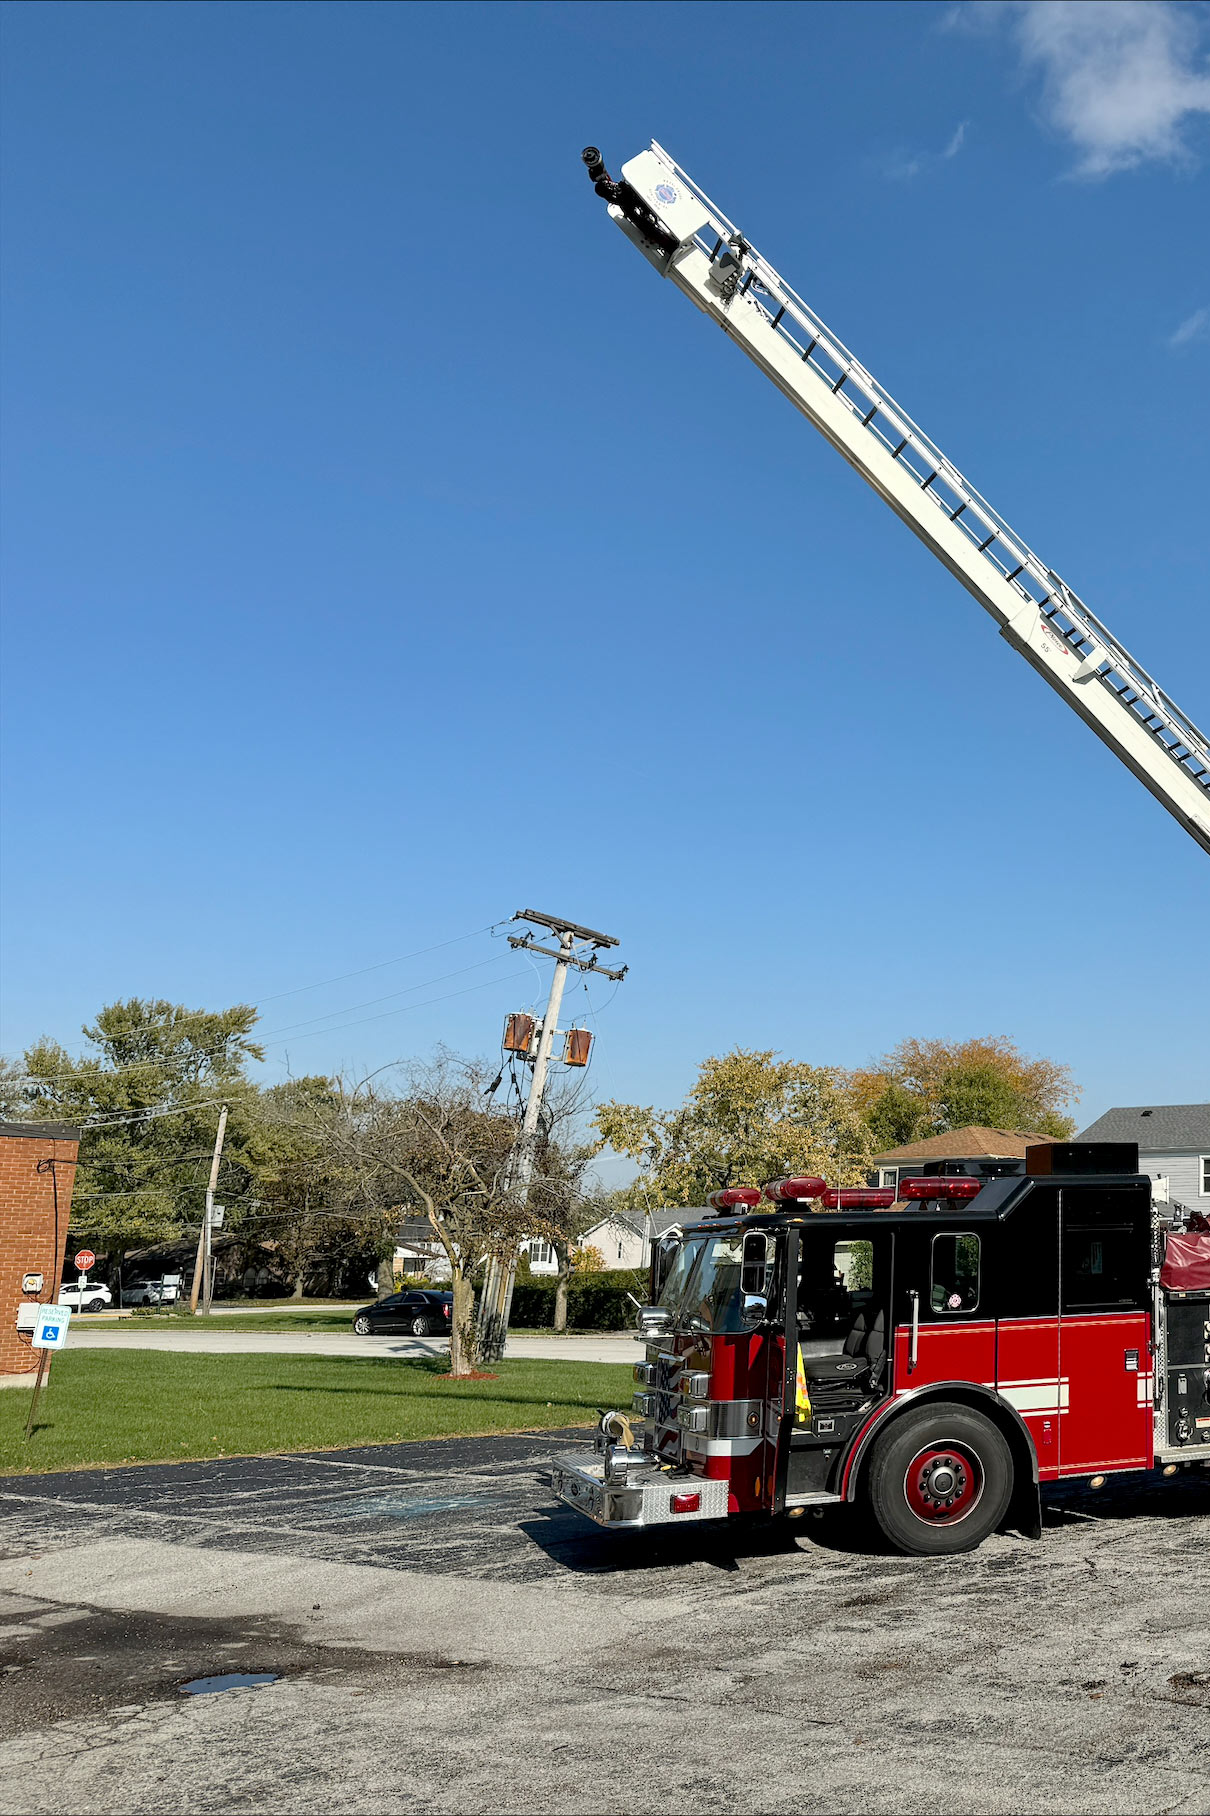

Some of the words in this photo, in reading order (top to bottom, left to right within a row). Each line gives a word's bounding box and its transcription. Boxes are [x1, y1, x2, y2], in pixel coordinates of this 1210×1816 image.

[76, 1255, 94, 1265] STOP
[41, 1307, 69, 1317] RESERVED
[41, 1315, 66, 1324] PARKING
